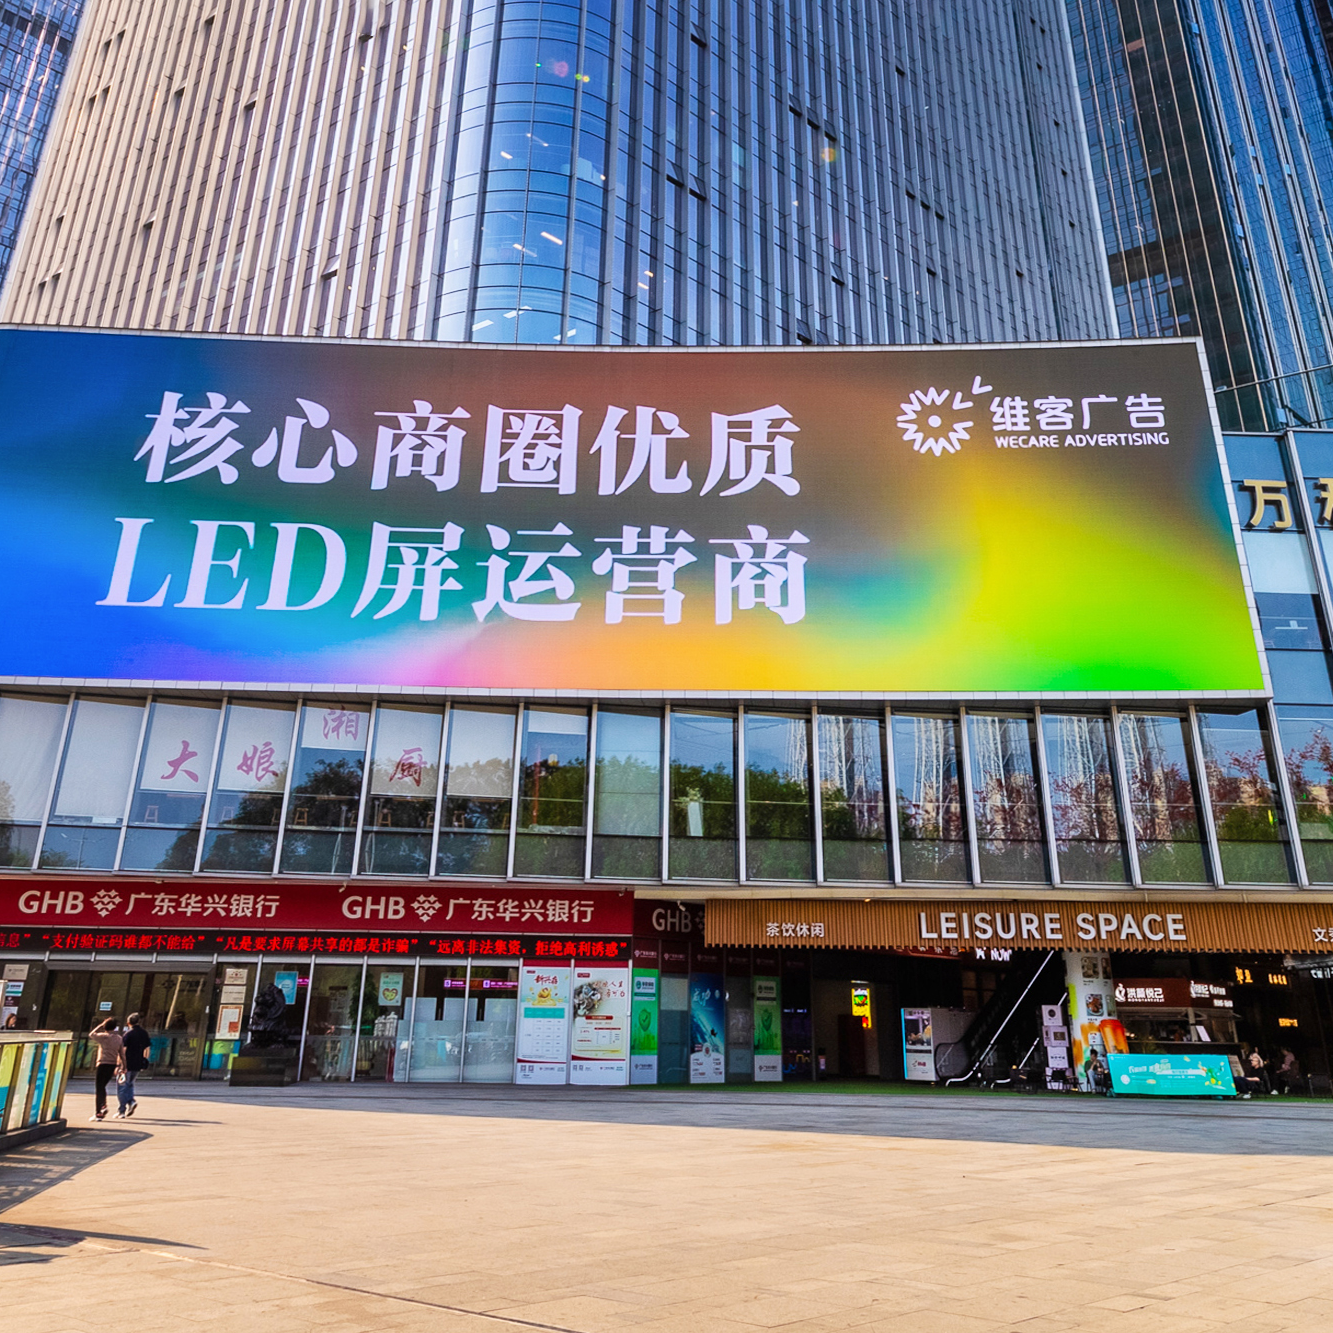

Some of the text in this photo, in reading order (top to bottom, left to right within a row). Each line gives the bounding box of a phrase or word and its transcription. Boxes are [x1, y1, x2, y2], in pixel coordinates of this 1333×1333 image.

[989, 393, 1165, 432] 维客广告
[134, 389, 800, 500] 核心商圈优质
[994, 432, 1170, 449] WECARE ADVERTISING
[95, 517, 809, 626] LED屏运营商
[18, 889, 85, 916] GHB
[125, 891, 280, 918] 广东华兴银行
[341, 894, 406, 921] GHB
[446, 896, 595, 924] 广东华兴银行
[652, 907, 693, 933] GHB
[766, 922, 825, 938] 茶饮休闲
[919, 911, 1187, 941] LEISURE SPACE
